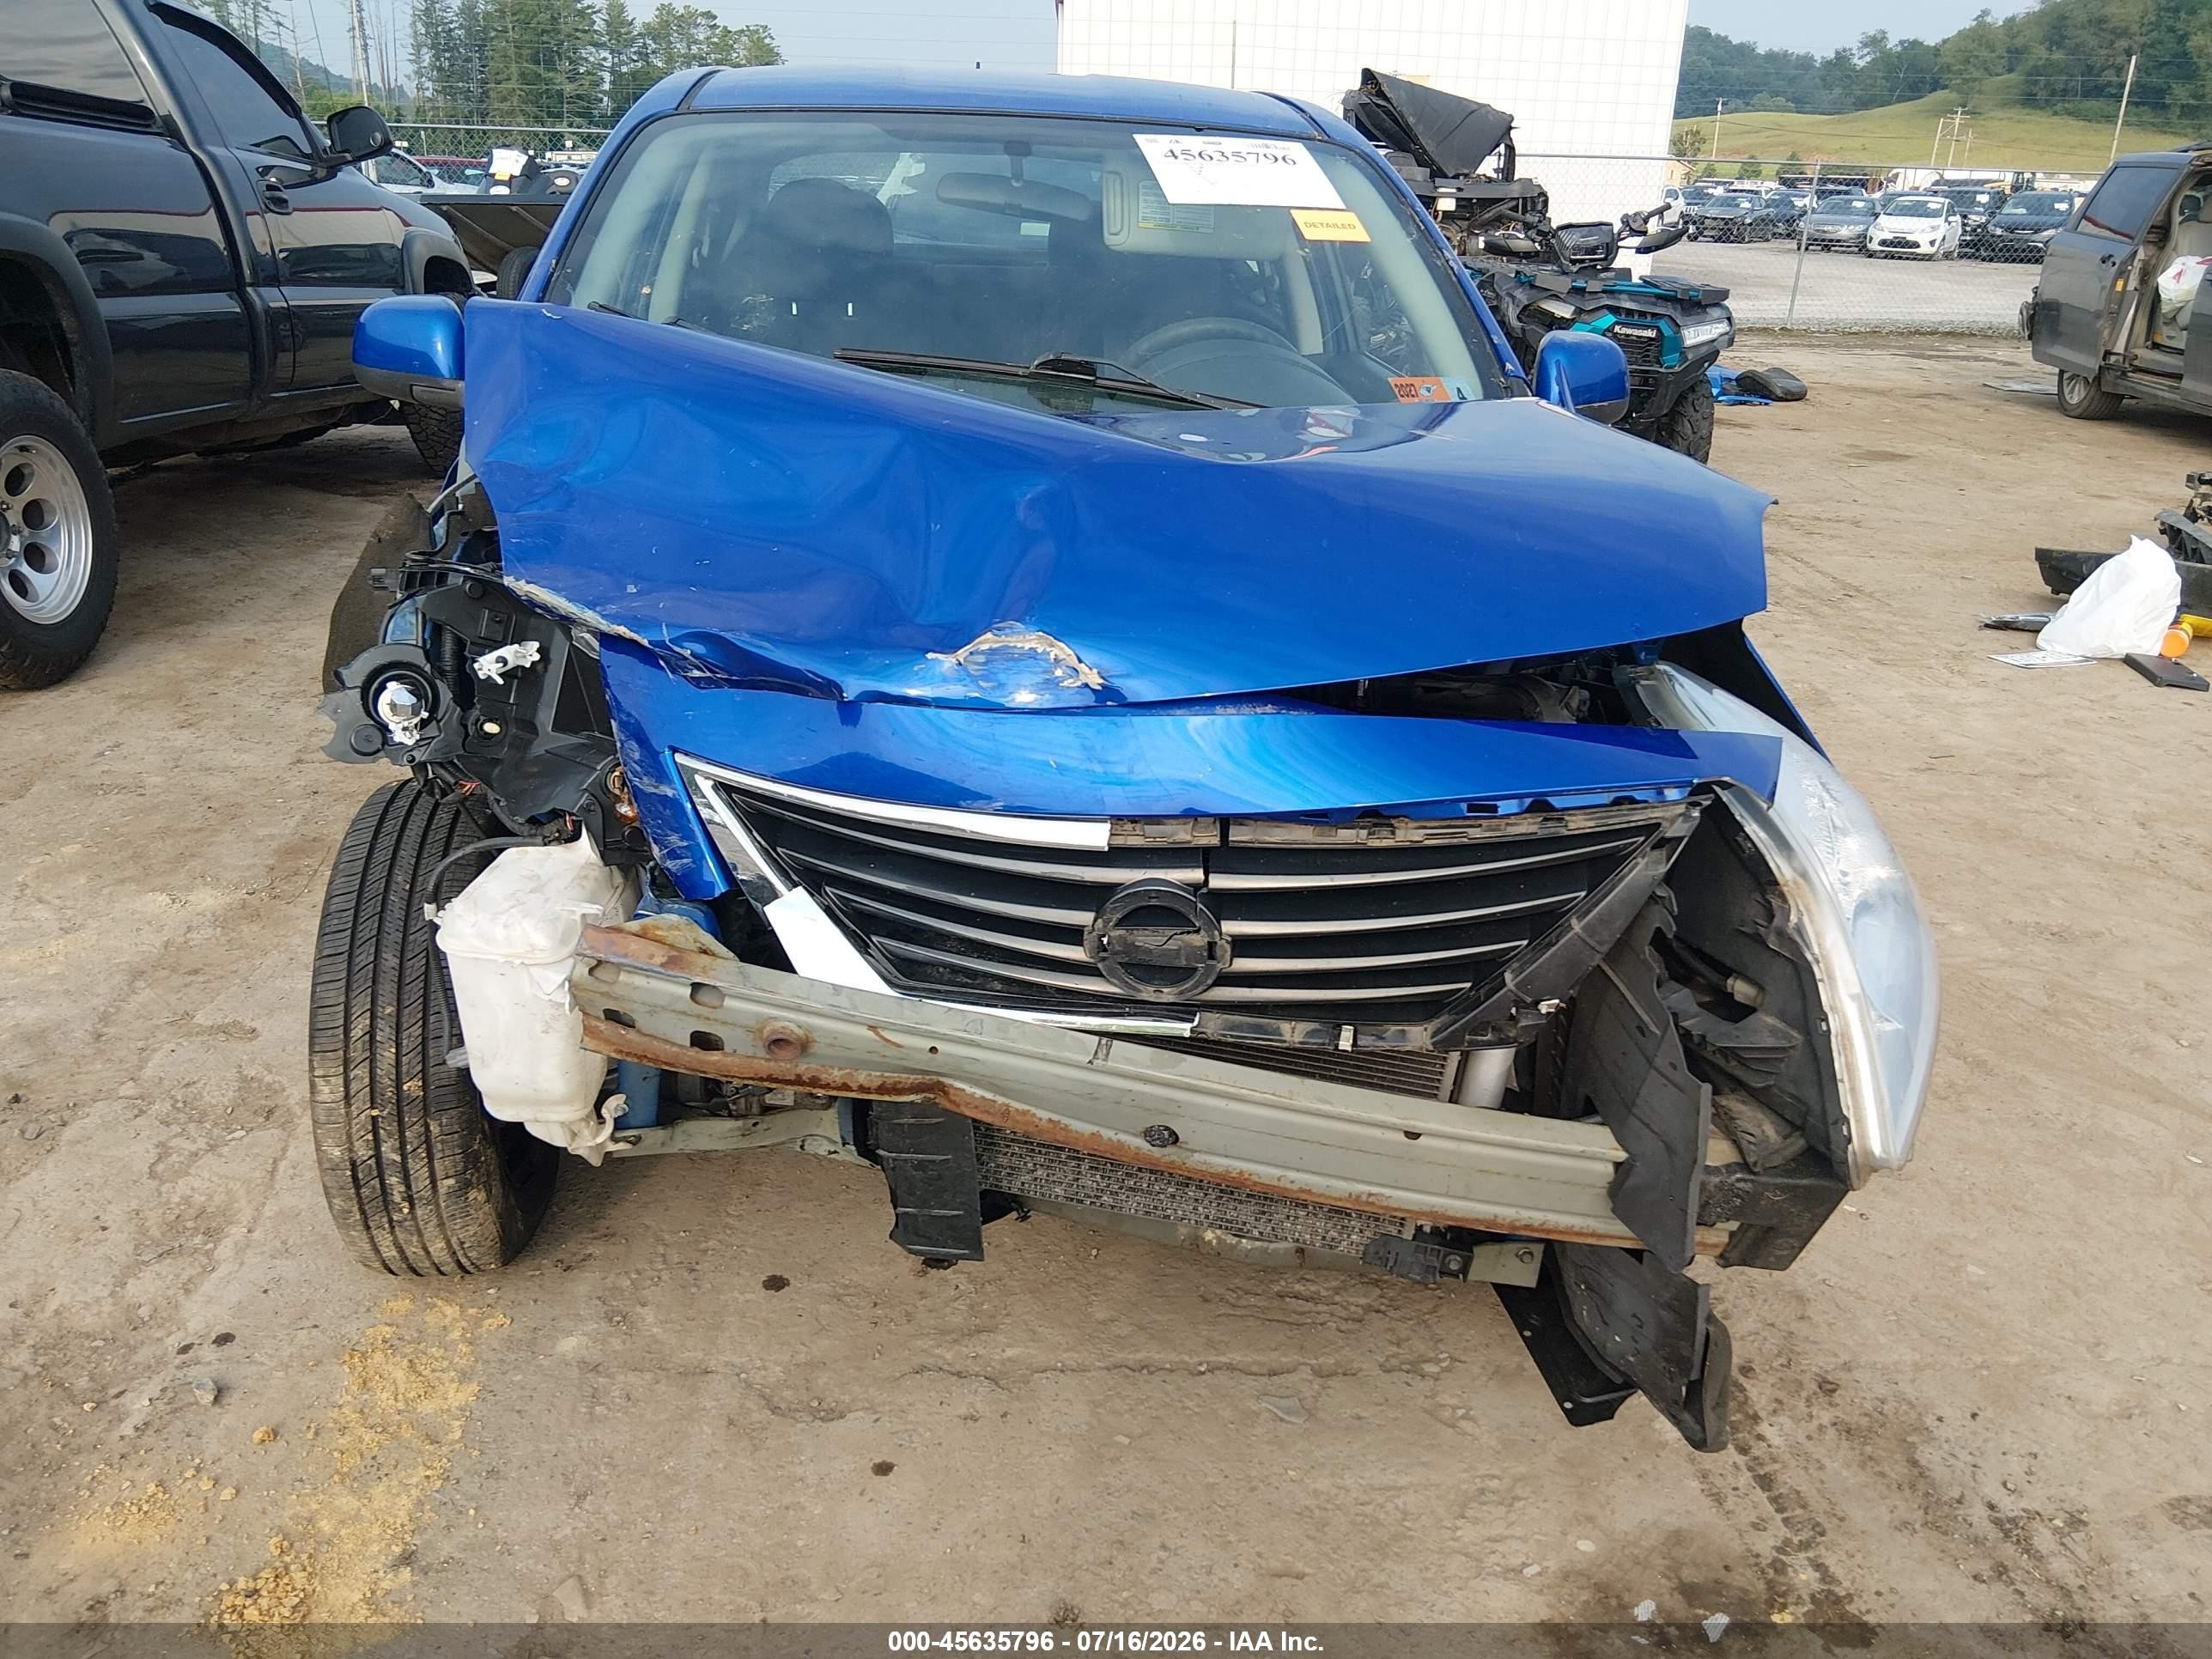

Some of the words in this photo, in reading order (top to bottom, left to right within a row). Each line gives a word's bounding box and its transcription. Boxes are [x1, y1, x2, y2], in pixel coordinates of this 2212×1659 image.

[1164, 149, 1297, 166] 45635796
[1304, 222, 1357, 230] DETAILED
[1613, 325, 1657, 338] Kawasaki
[1394, 383, 1419, 398] 2027
